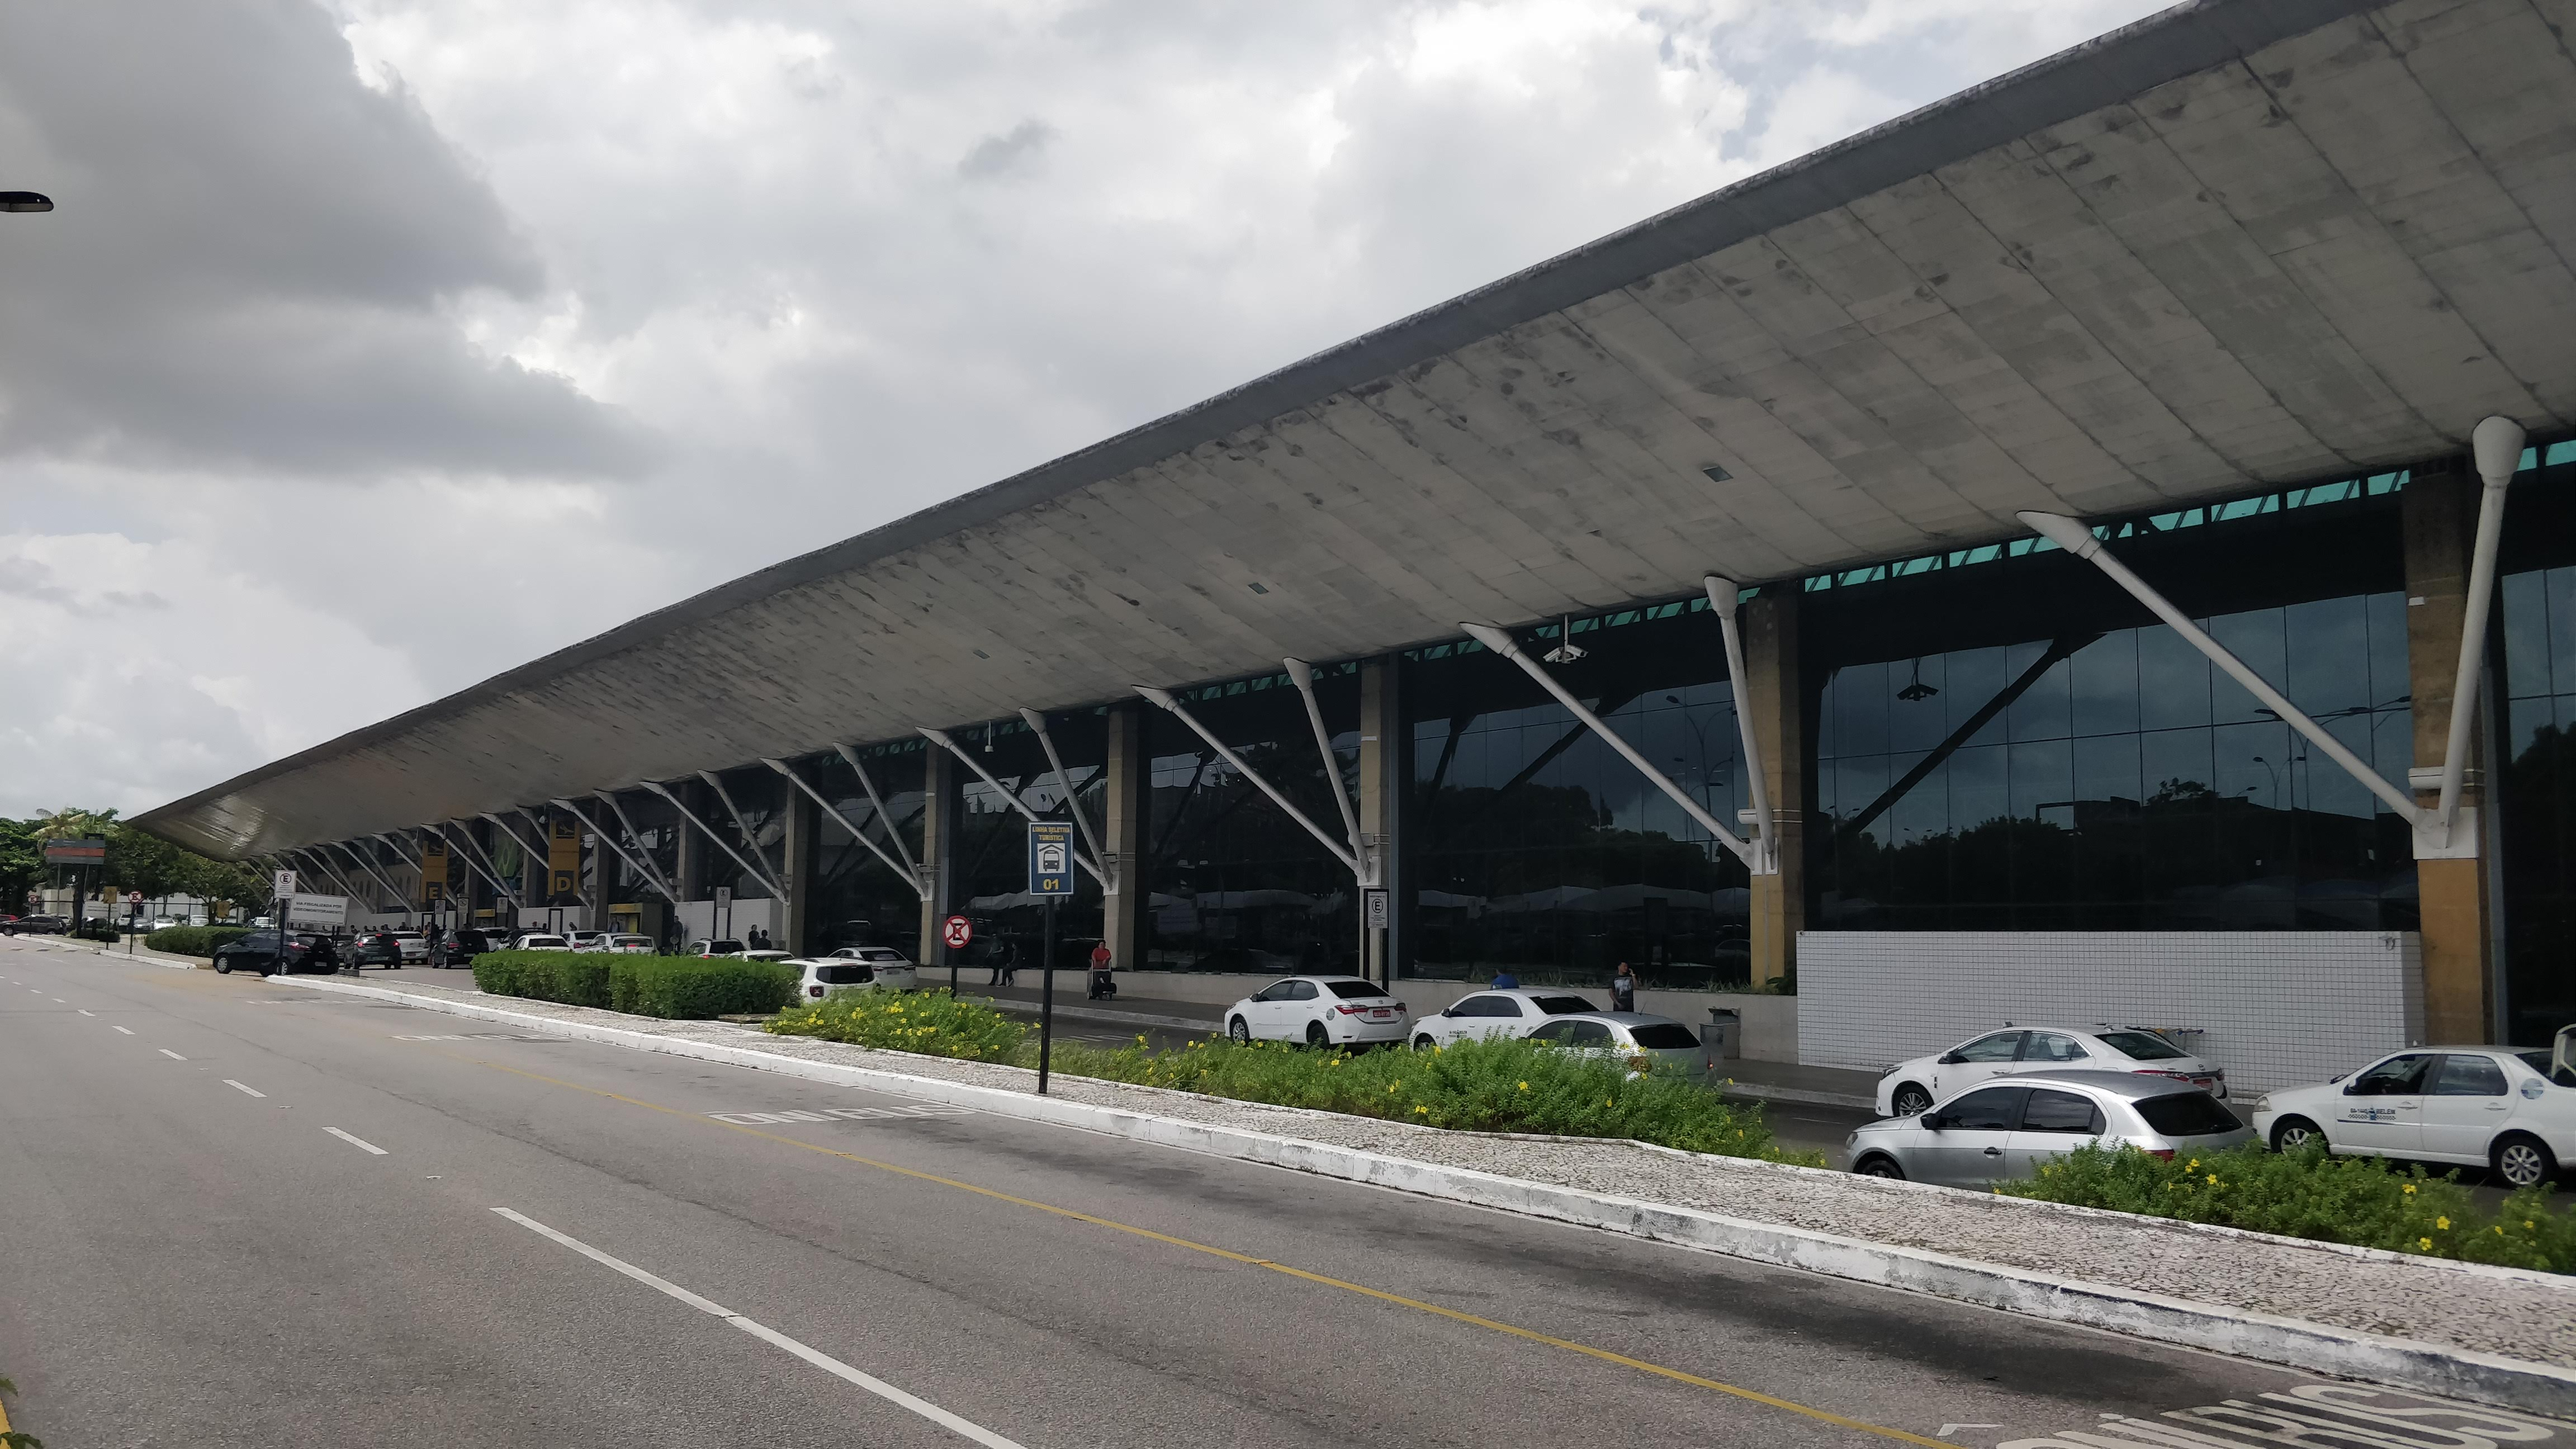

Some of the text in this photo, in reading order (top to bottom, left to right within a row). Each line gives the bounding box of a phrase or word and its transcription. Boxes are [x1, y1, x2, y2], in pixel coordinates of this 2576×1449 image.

[556, 877, 571, 892] D
[1043, 878, 1059, 891] 01
[429, 887, 438, 899] E
[1375, 901, 1380, 911] E
